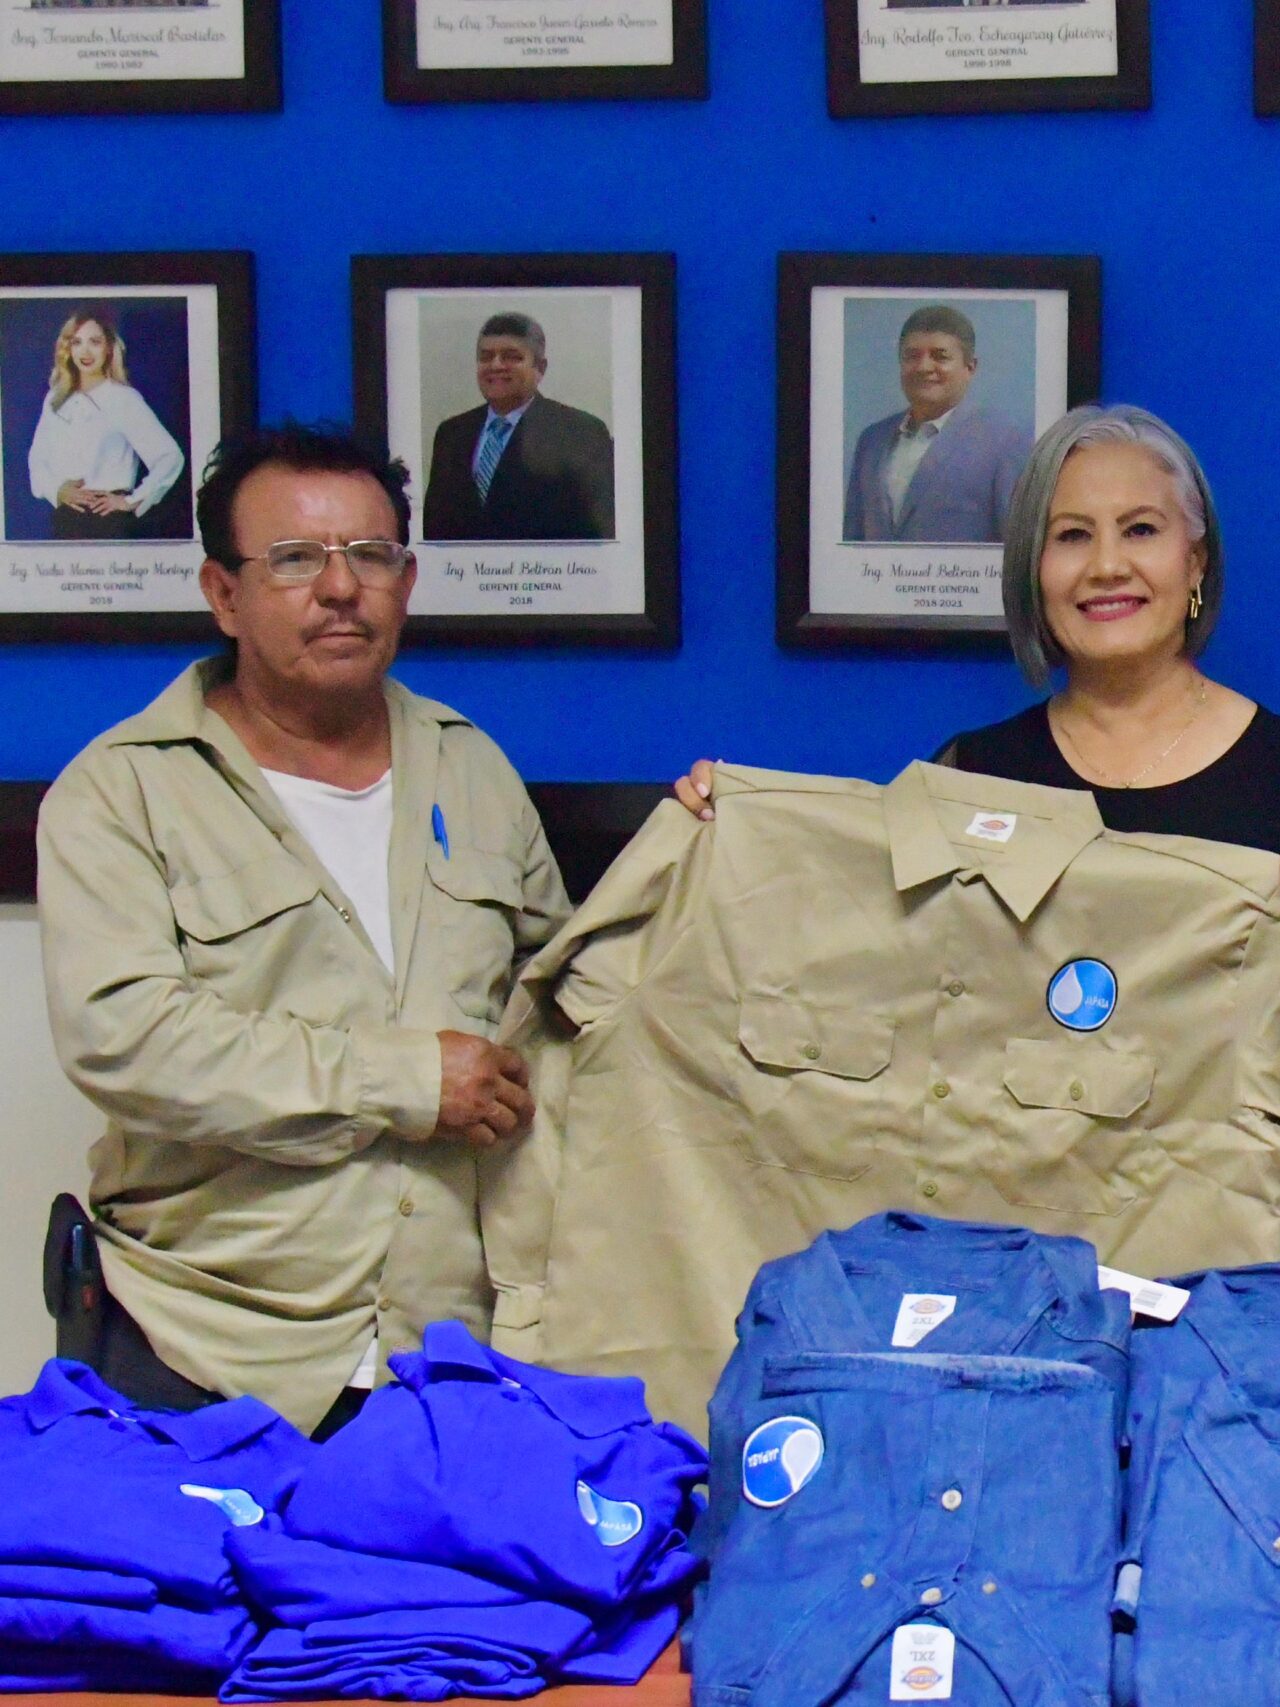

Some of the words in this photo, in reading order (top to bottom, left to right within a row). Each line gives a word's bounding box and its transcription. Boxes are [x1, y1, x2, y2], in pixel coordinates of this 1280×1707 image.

[43, 27, 104, 44] Fernando
[167, 26, 226, 43] Bastidas
[504, 36, 542, 45] GERENTE
[545, 35, 584, 44] GENERAL
[893, 27, 944, 47] Rodolfo
[77, 49, 117, 58] GERENTE
[119, 49, 160, 58] GENERAL
[945, 48, 985, 57] GERENTE
[988, 47, 1028, 57] GENERAL
[154, 561, 194, 581] Montoya
[474, 562, 514, 576] Manuel
[889, 563, 932, 578] Manuel
[60, 582, 100, 592] GERENTE
[103, 582, 144, 591] GENERAL
[479, 583, 518, 592] GERENTE
[522, 583, 563, 591] GENERAL
[895, 584, 936, 594] GERENTE
[939, 585, 980, 594] GENERAL
[89, 596, 113, 605] 2018
[509, 596, 533, 605] 2018
